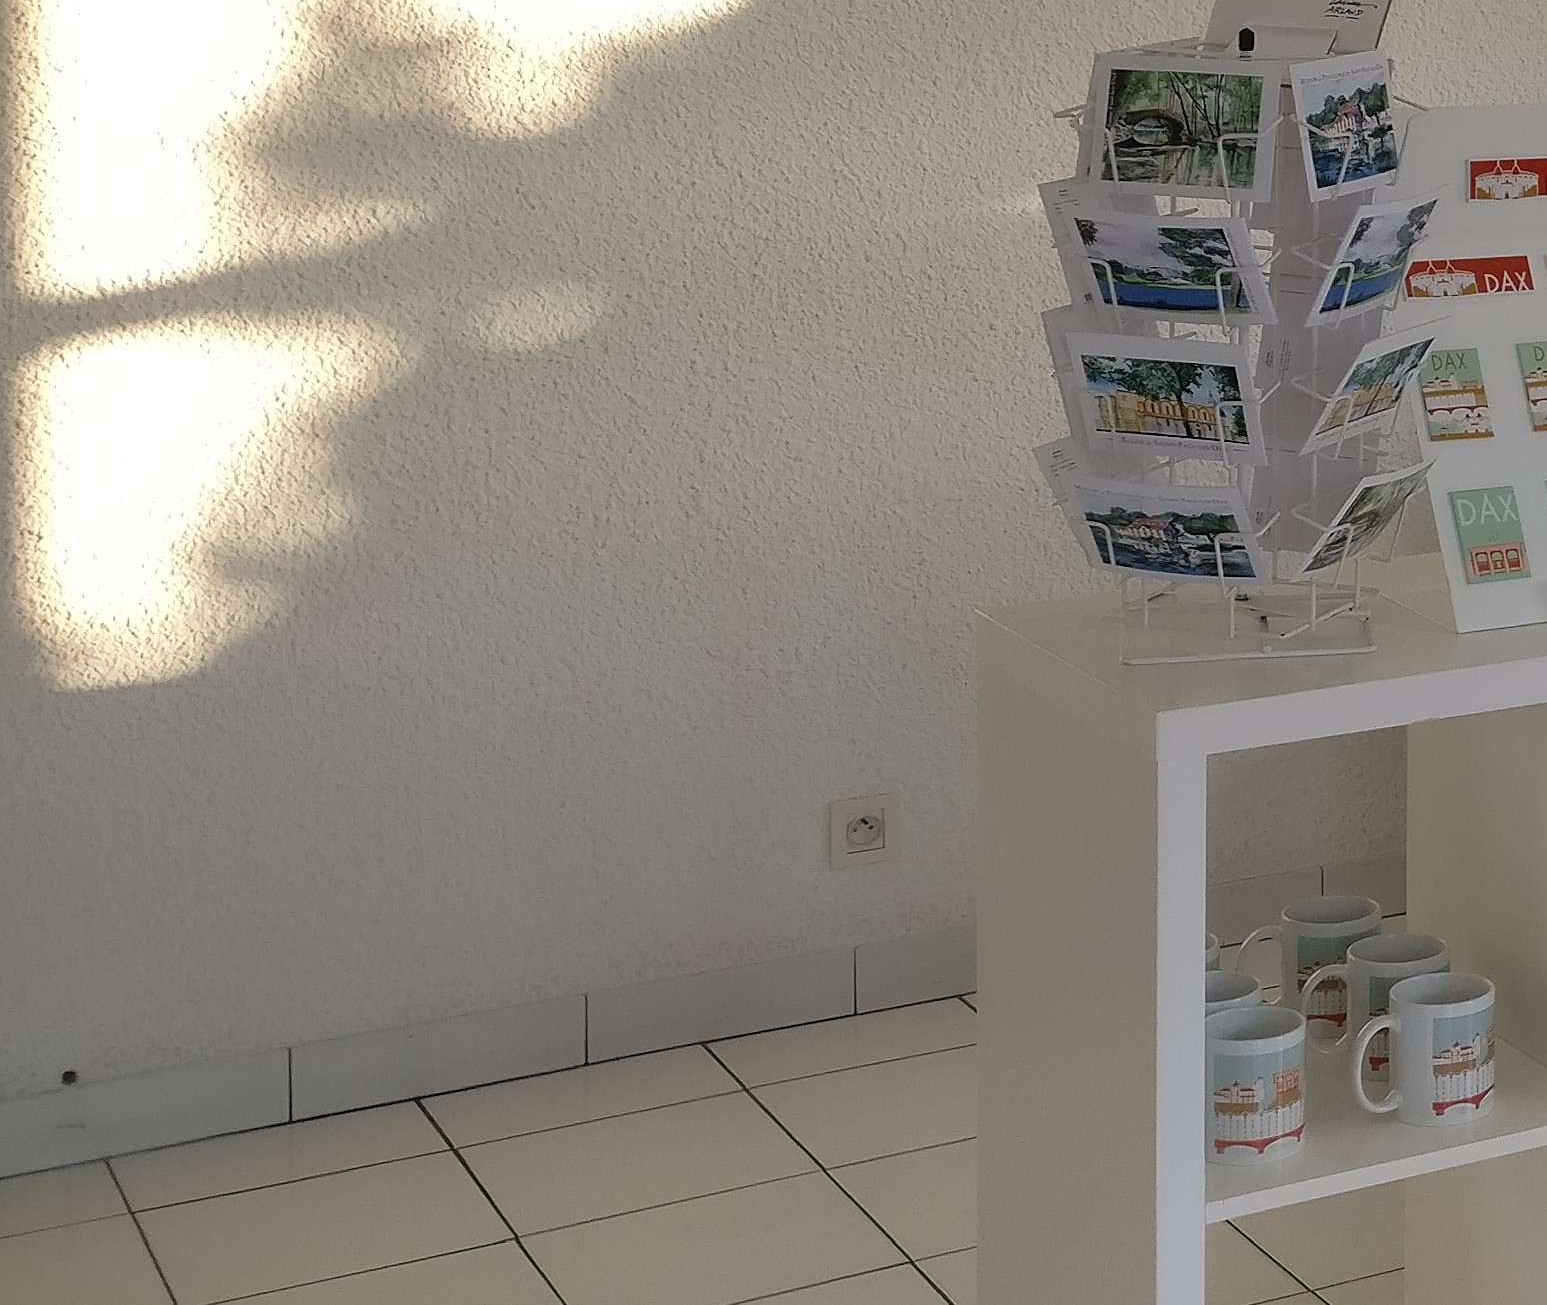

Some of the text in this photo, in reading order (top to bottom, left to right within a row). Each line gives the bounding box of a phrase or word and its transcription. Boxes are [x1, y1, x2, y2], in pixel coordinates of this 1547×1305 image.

[1484, 270, 1529, 293] DAX
[1431, 353, 1468, 371] DAX
[1456, 493, 1521, 527] DAX
